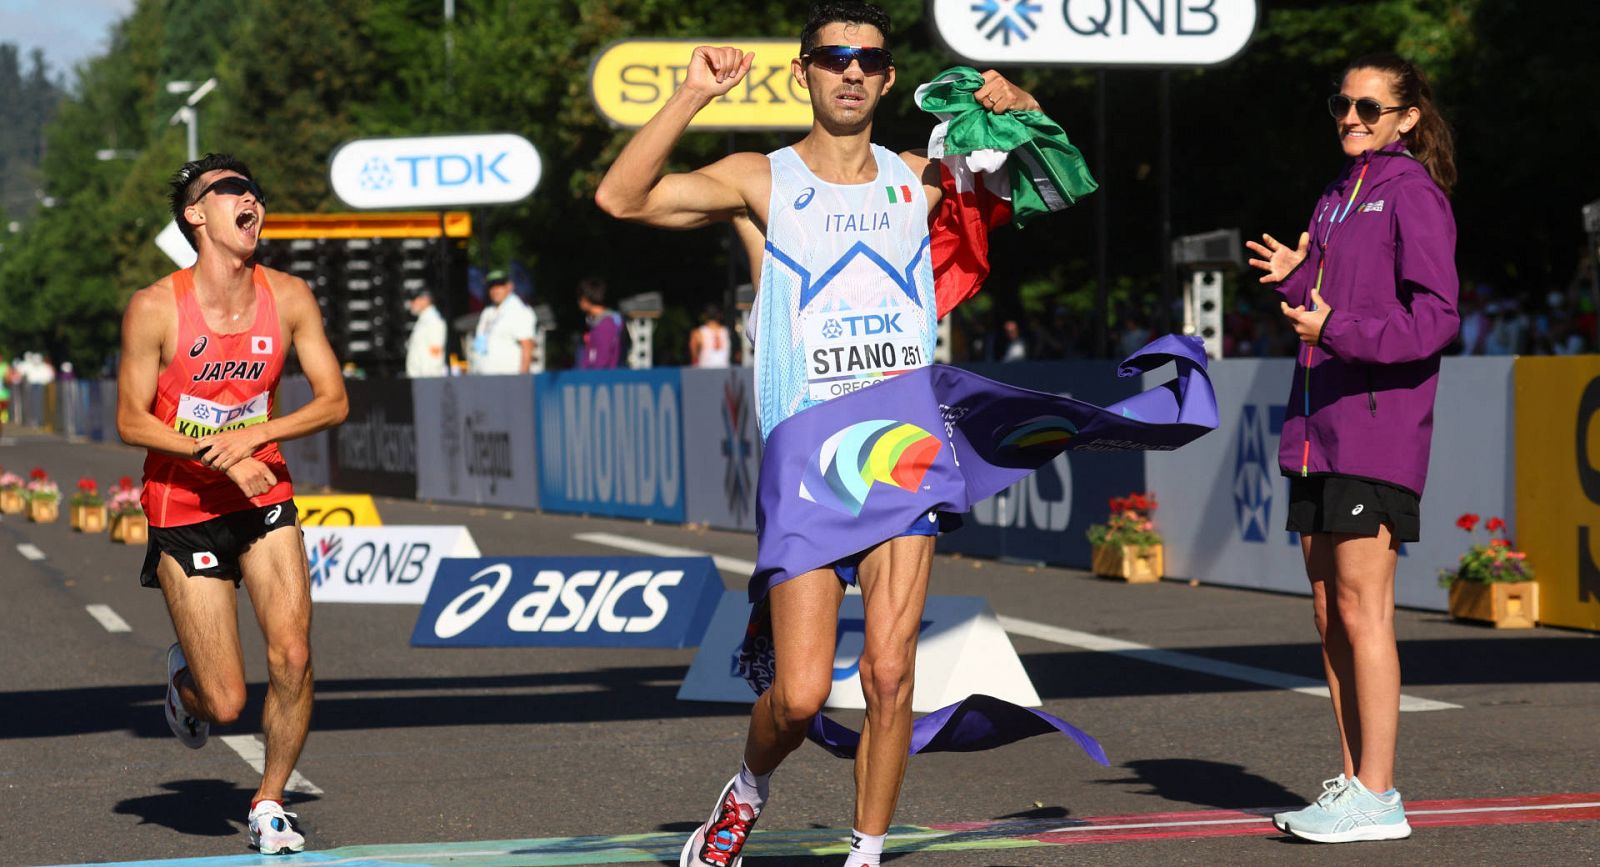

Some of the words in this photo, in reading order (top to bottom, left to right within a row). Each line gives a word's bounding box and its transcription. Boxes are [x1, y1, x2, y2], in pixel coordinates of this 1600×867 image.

[1062, 0, 1219, 38] QNB
[394, 151, 511, 187] TDK
[825, 211, 891, 233] ITALIA
[842, 312, 904, 337] TDK
[192, 361, 266, 382] JAPAN
[812, 342, 897, 375] STANO
[901, 345, 922, 366] 251
[210, 399, 257, 424] TDK
[562, 382, 680, 508] MONDO
[344, 541, 431, 585] QNB
